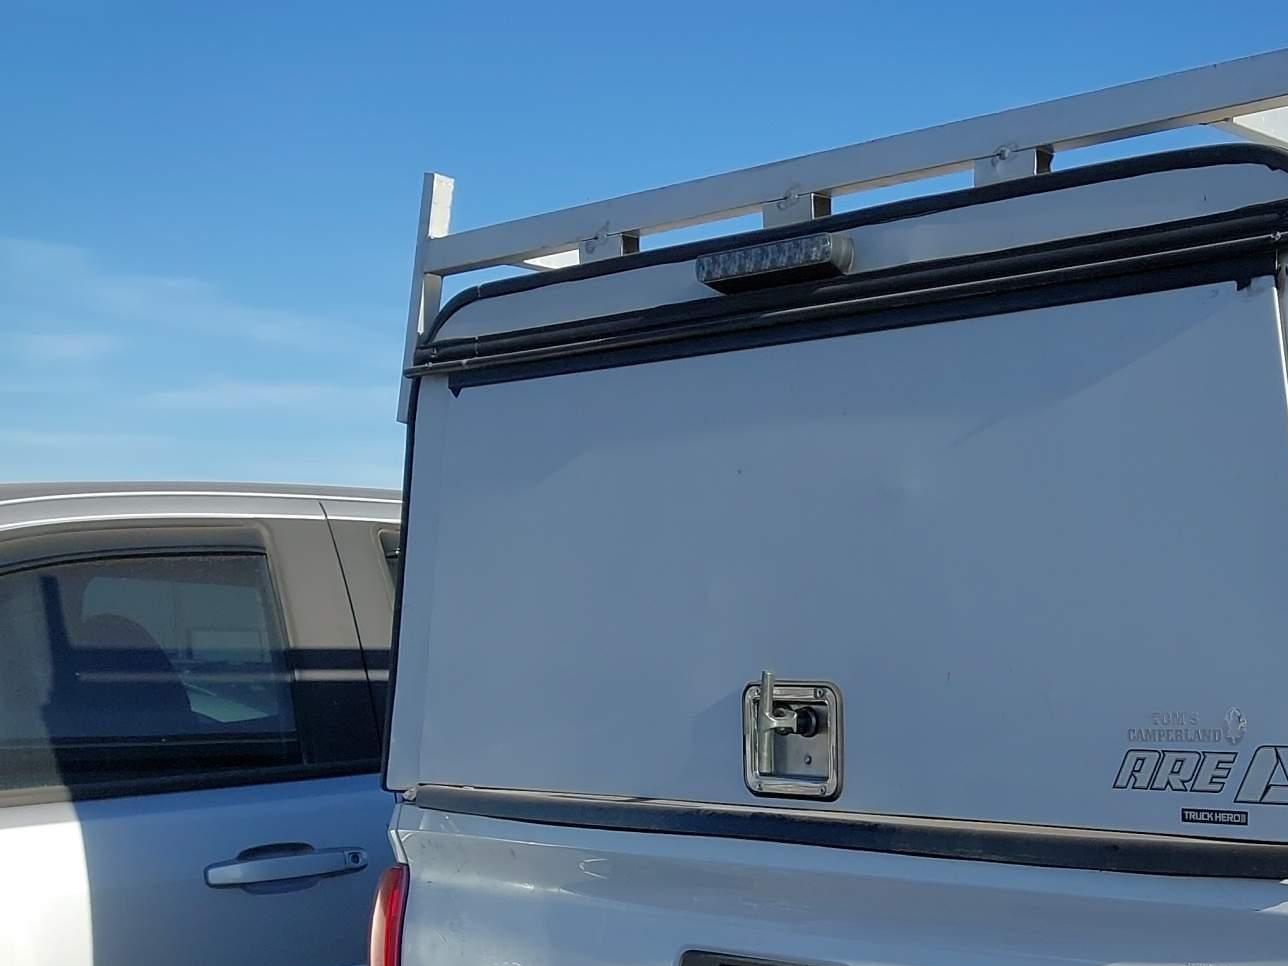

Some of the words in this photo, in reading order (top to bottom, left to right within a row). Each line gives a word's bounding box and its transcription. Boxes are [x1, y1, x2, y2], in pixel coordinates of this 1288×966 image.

[1127, 727, 1224, 742] CAMPERLAND
[1112, 748, 1239, 793] ARE
[1184, 810, 1214, 822] TRUCK
